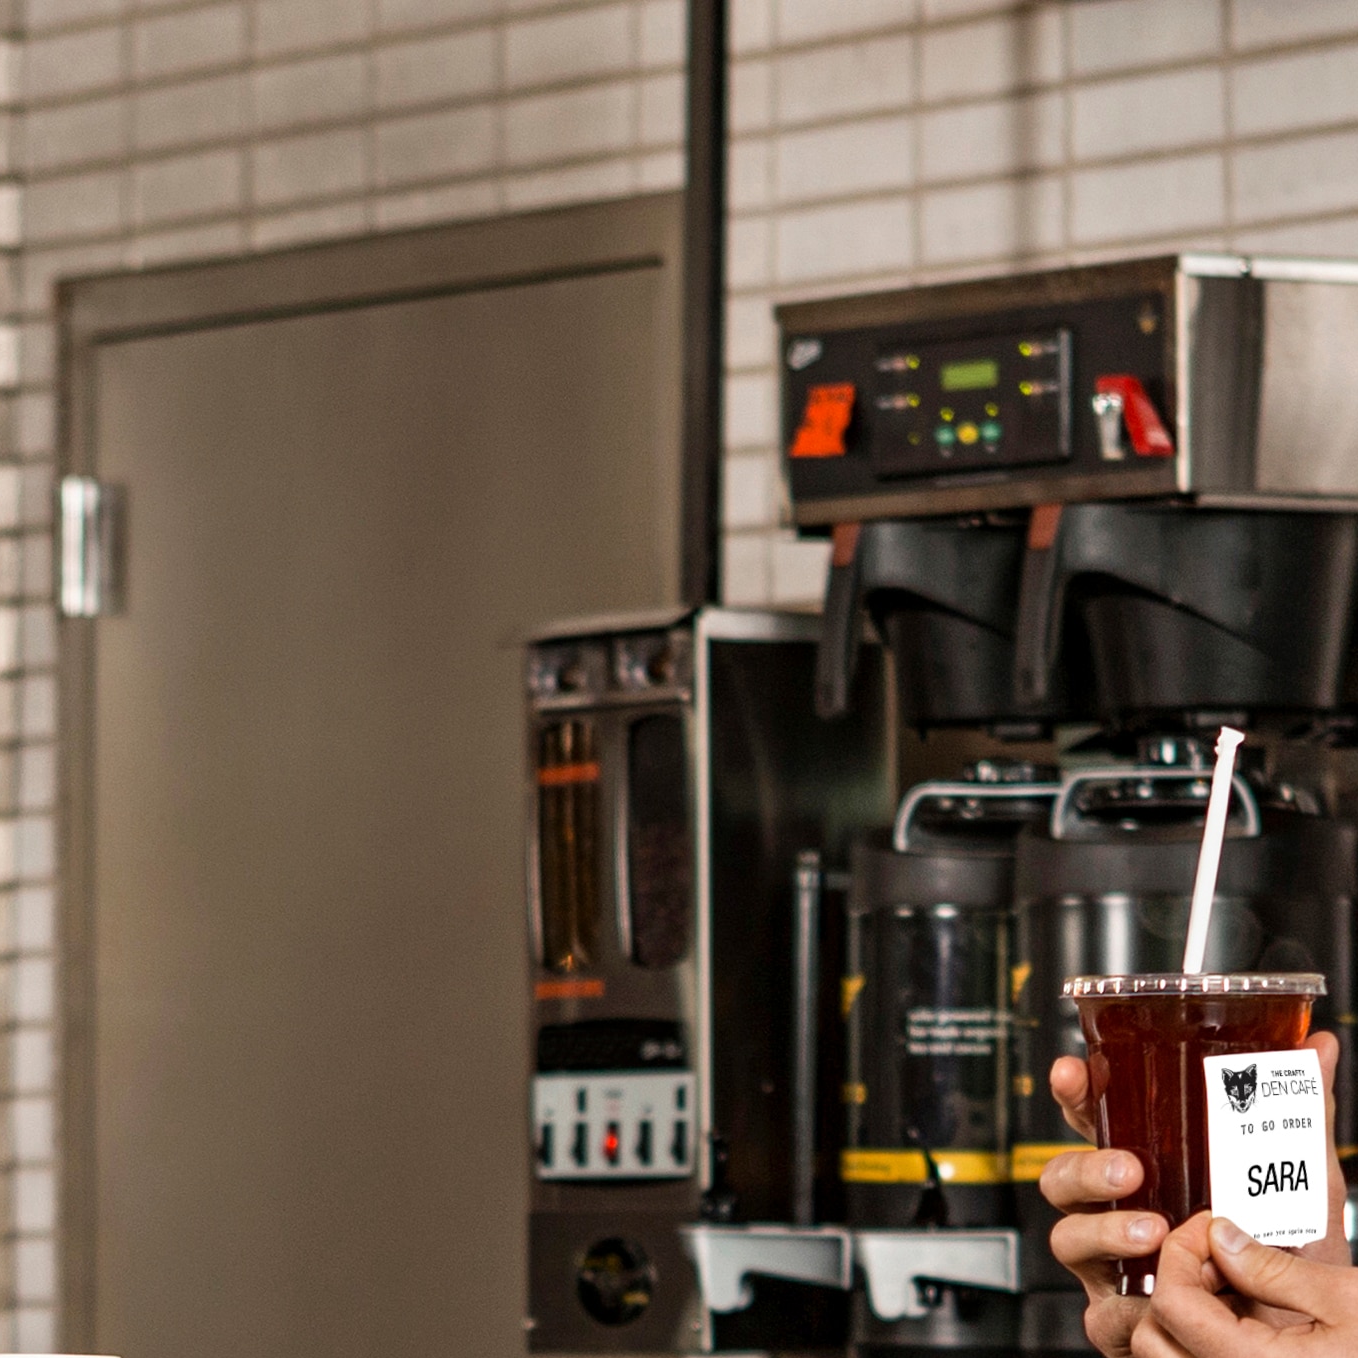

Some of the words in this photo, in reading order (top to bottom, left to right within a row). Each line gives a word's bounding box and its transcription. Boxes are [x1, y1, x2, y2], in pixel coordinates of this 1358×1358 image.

[1271, 1069, 1283, 1077] THE
[1284, 1069, 1306, 1077] CRAFTY
[1261, 1081, 1288, 1097] DEN
[1290, 1077, 1319, 1095] CAFÉ
[1240, 1123, 1254, 1135] TO
[1261, 1120, 1275, 1132] GO
[1282, 1117, 1312, 1129] ORDER
[1247, 1160, 1309, 1197] SARA
